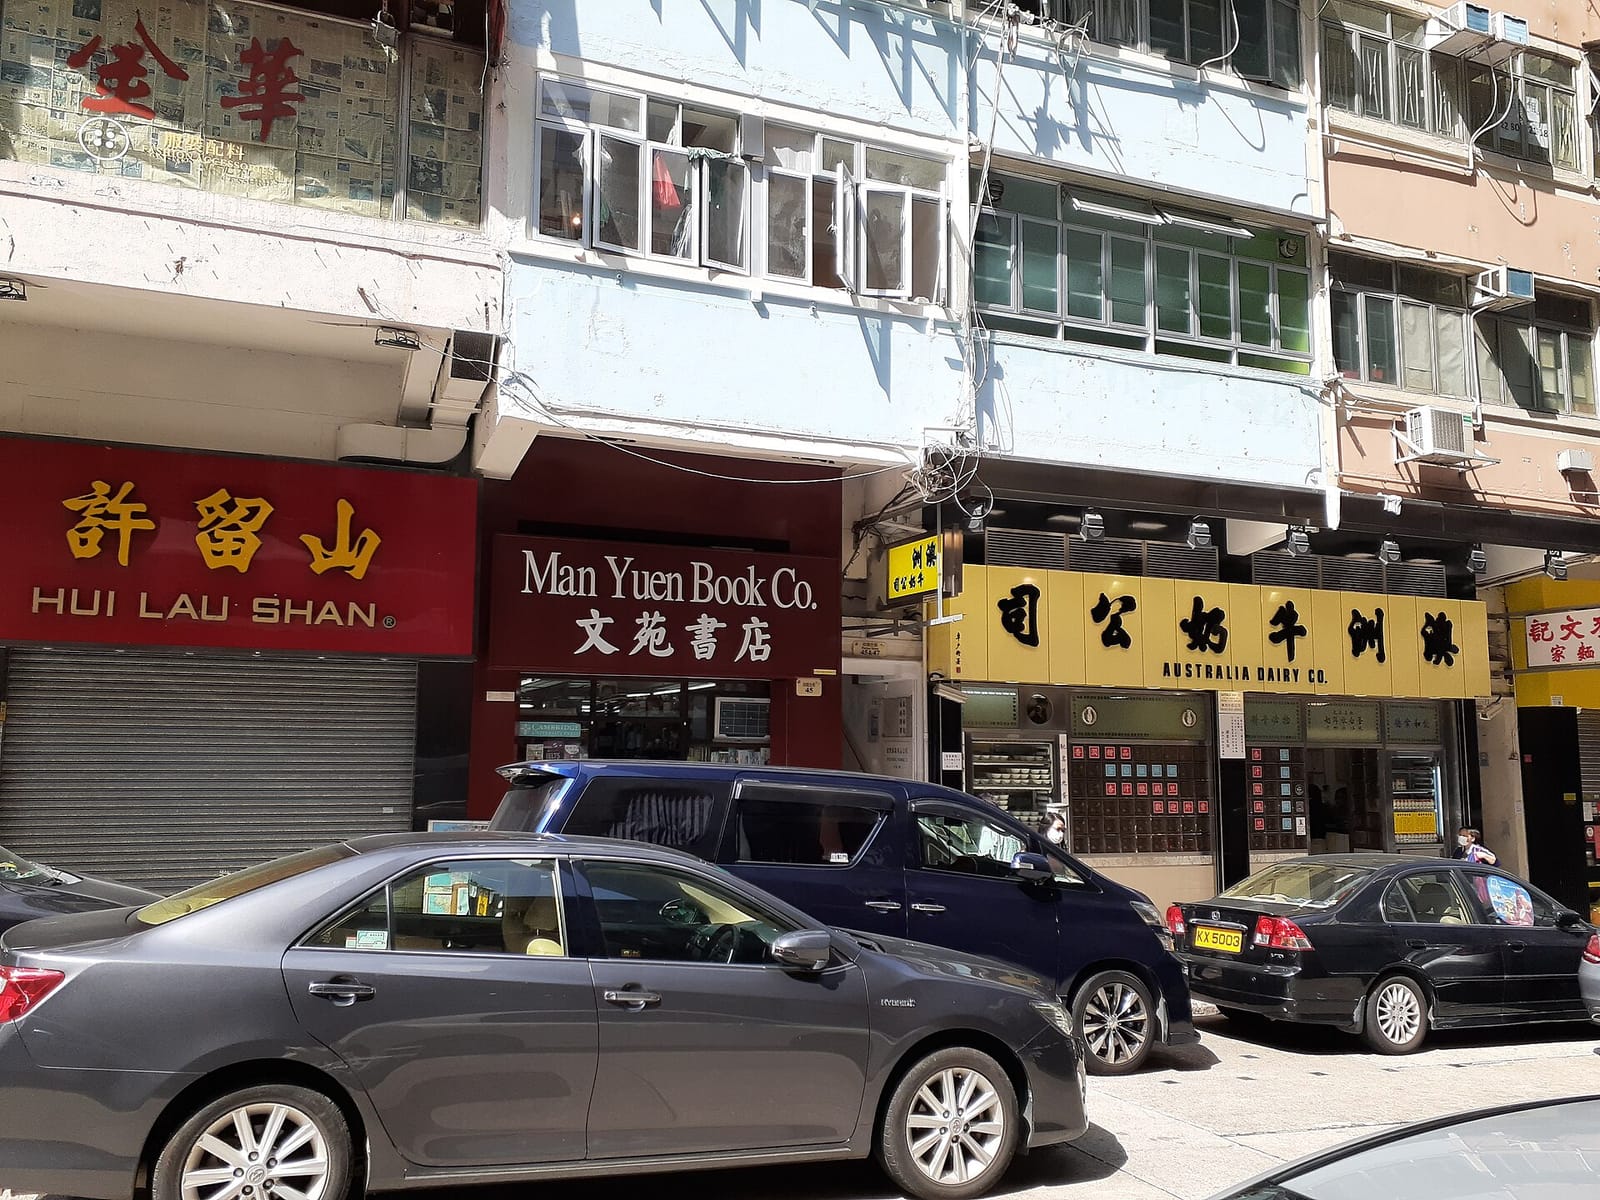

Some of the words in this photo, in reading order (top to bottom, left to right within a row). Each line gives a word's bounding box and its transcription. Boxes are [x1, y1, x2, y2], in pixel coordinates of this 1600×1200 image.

[62, 480, 381, 580] 許留山
[521, 550, 598, 597] Man
[604, 555, 685, 603] Yuen
[690, 561, 766, 607] Book
[771, 567, 818, 610] Co.
[32, 587, 115, 617] HUI
[139, 592, 229, 622] LAU
[252, 597, 376, 628] SHAN
[573, 608, 773, 663] 文苑書店
[1163, 661, 1250, 681] AUSTRALIA
[1257, 665, 1300, 684] DAIRY
[1308, 667, 1329, 685] CO.
[1196, 930, 1210, 941] KX
[1211, 932, 1240, 947] 5003
